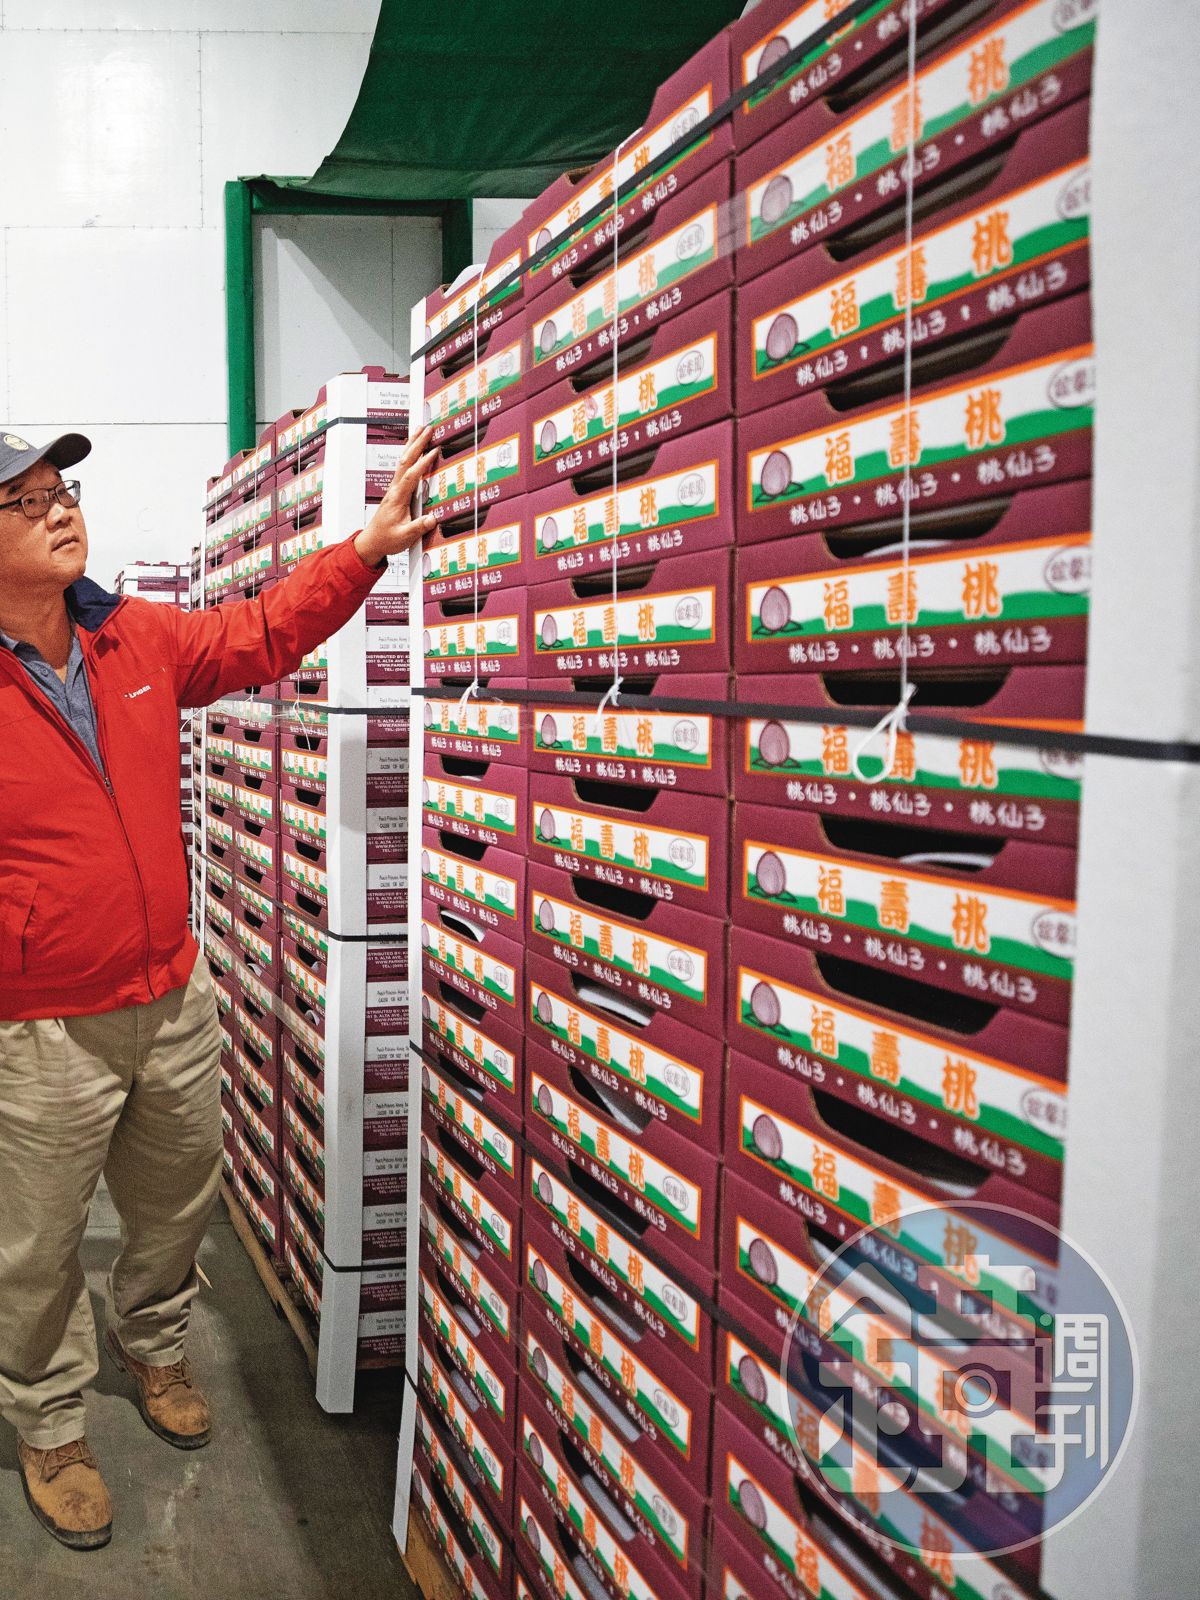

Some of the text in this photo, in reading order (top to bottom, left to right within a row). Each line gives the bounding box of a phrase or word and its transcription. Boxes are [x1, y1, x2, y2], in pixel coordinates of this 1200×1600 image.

[826, 37, 1009, 191] 福壽桃
[830, 211, 1012, 338] 福壽桃
[824, 389, 1005, 485] 福壽桃
[823, 561, 1002, 629] 福壽桃
[818, 866, 990, 953] 福壽桃
[810, 1005, 979, 1120] 福壽桃
